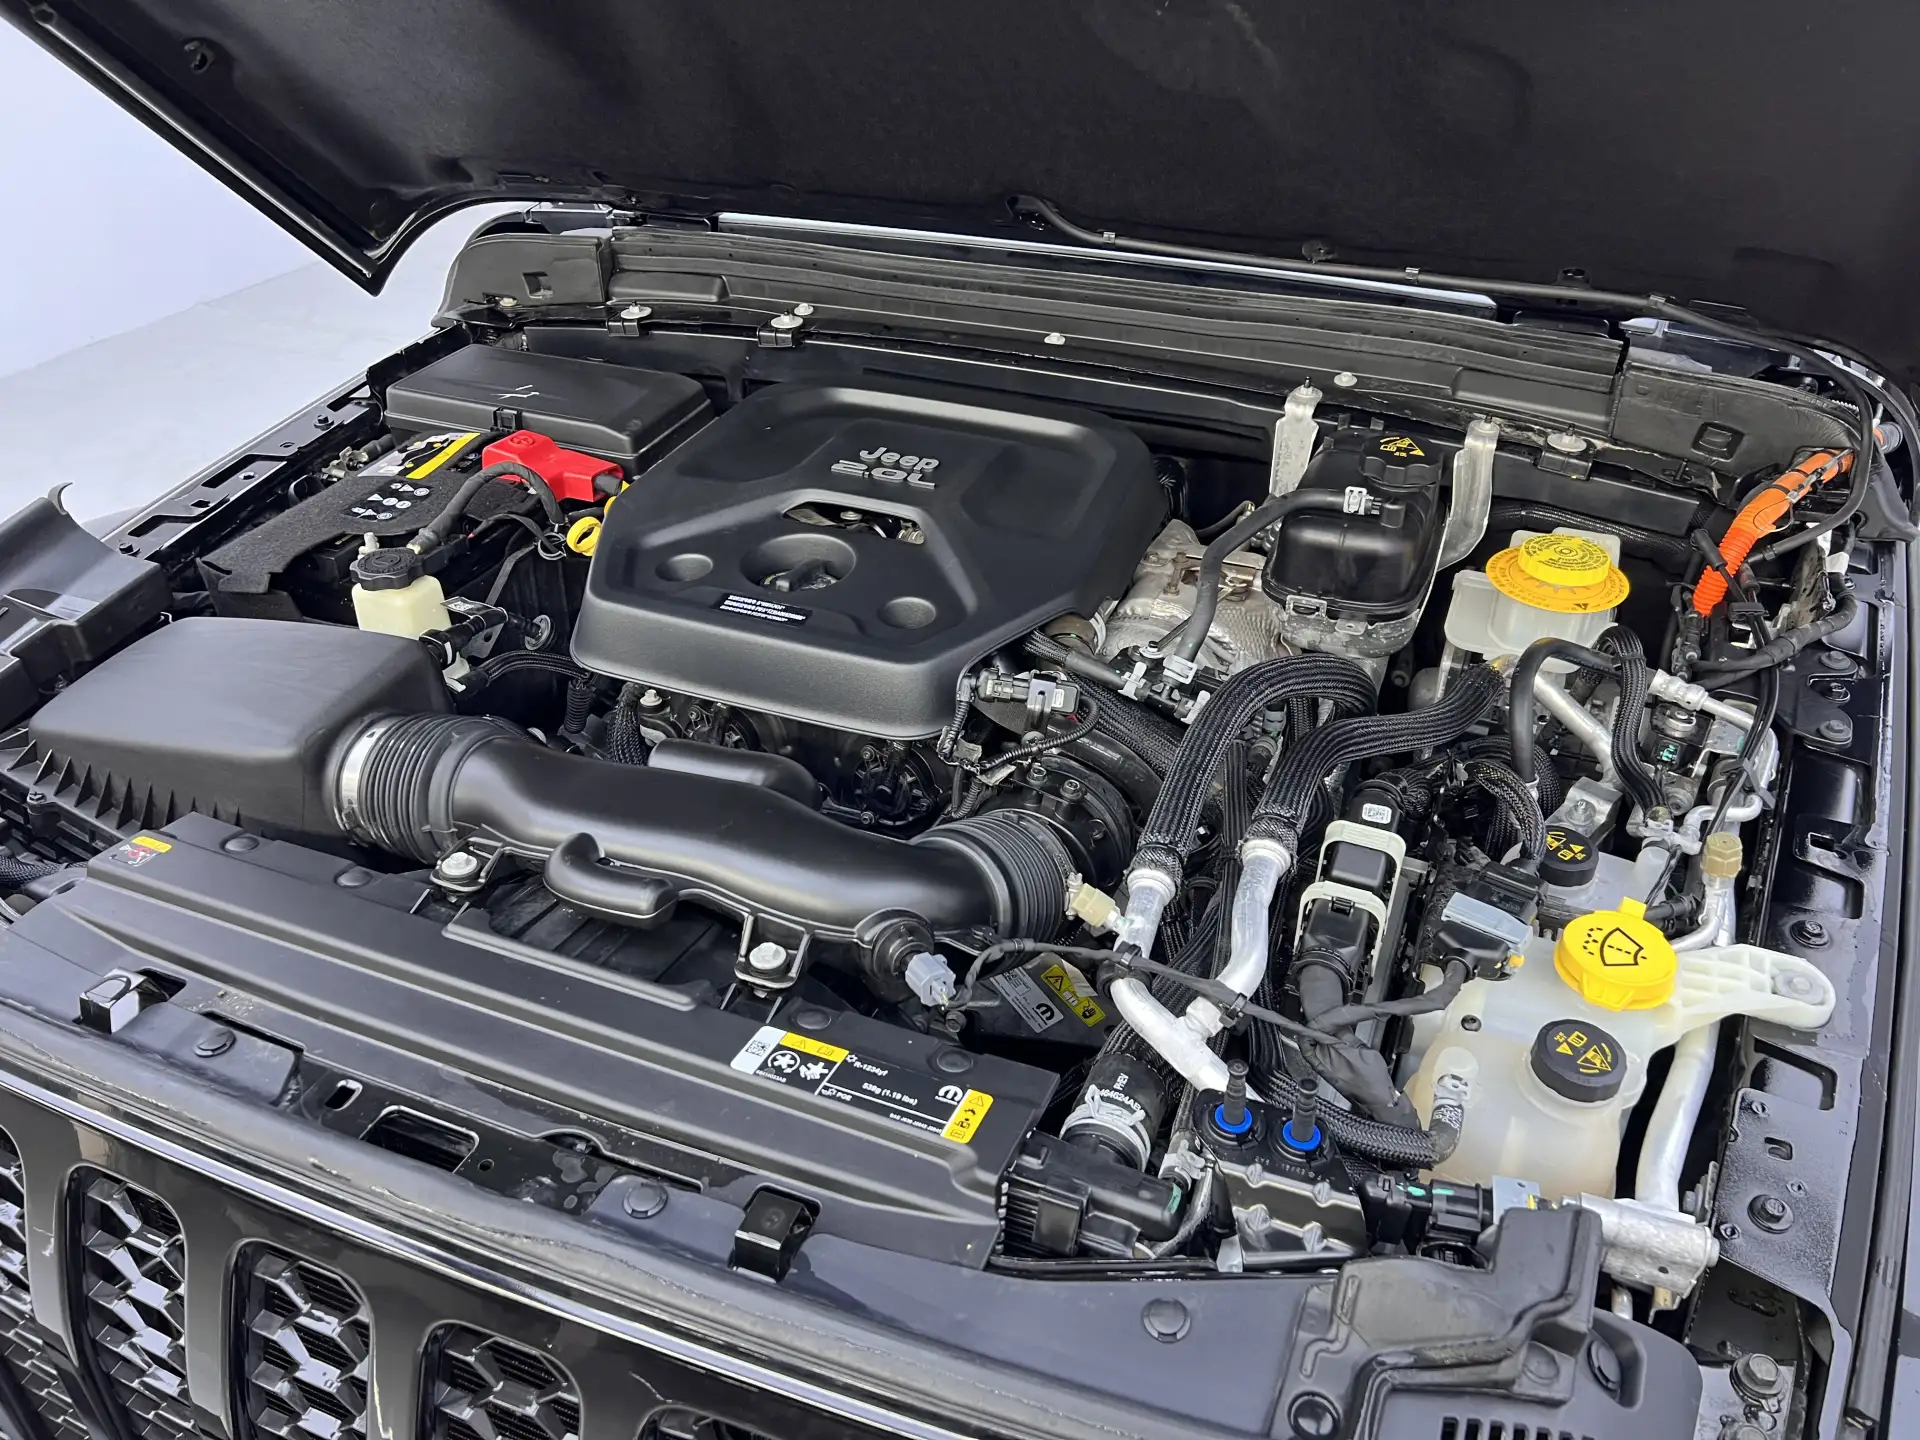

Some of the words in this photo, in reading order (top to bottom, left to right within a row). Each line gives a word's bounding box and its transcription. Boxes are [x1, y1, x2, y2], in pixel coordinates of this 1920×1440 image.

[859, 446, 940, 473] Jeep
[830, 459, 936, 490] 2.0L
[853, 1060, 889, 1076] R-1234yf
